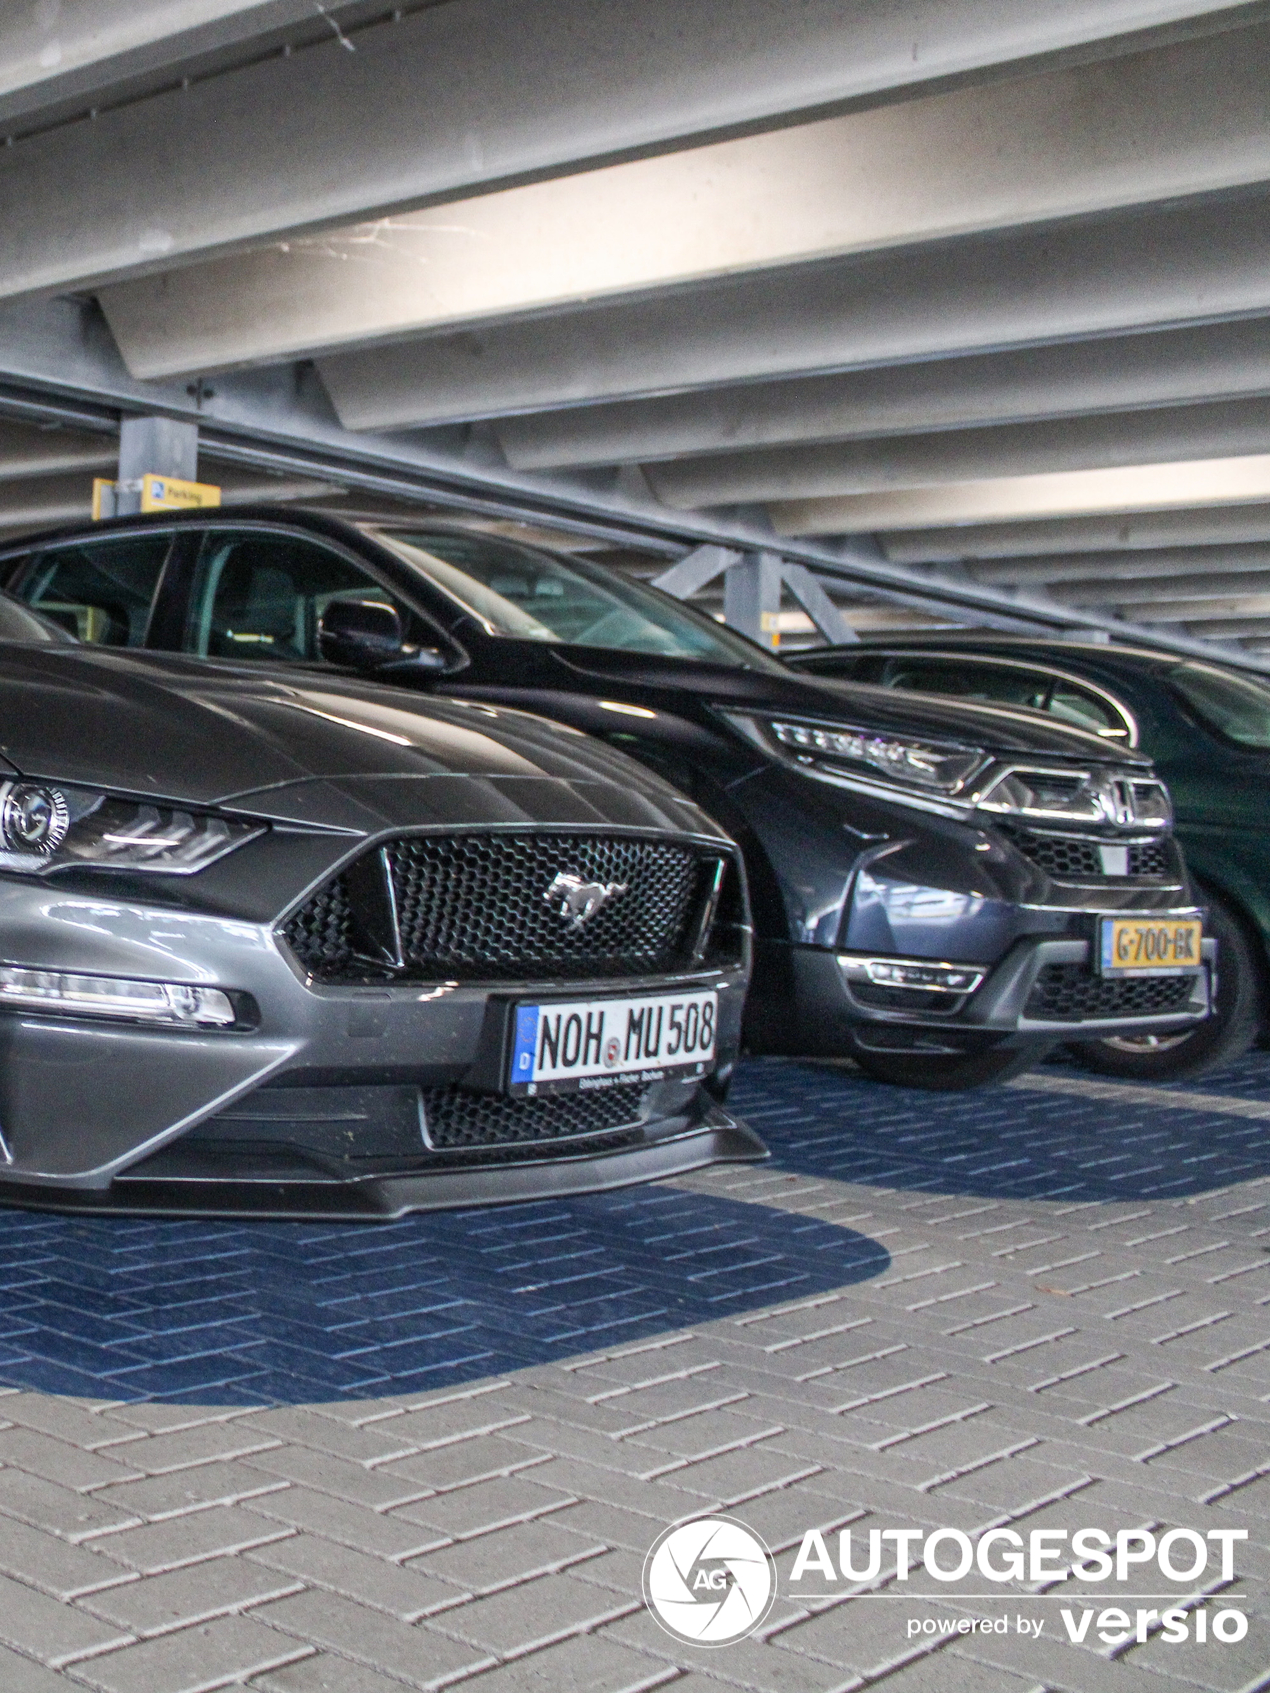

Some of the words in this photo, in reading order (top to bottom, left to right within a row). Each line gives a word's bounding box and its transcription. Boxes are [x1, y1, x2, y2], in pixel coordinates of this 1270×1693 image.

[167, 487, 203, 505] Parking
[1118, 928, 1195, 961] G-700-BK
[538, 1011, 604, 1071] NOH
[519, 1052, 530, 1070] D
